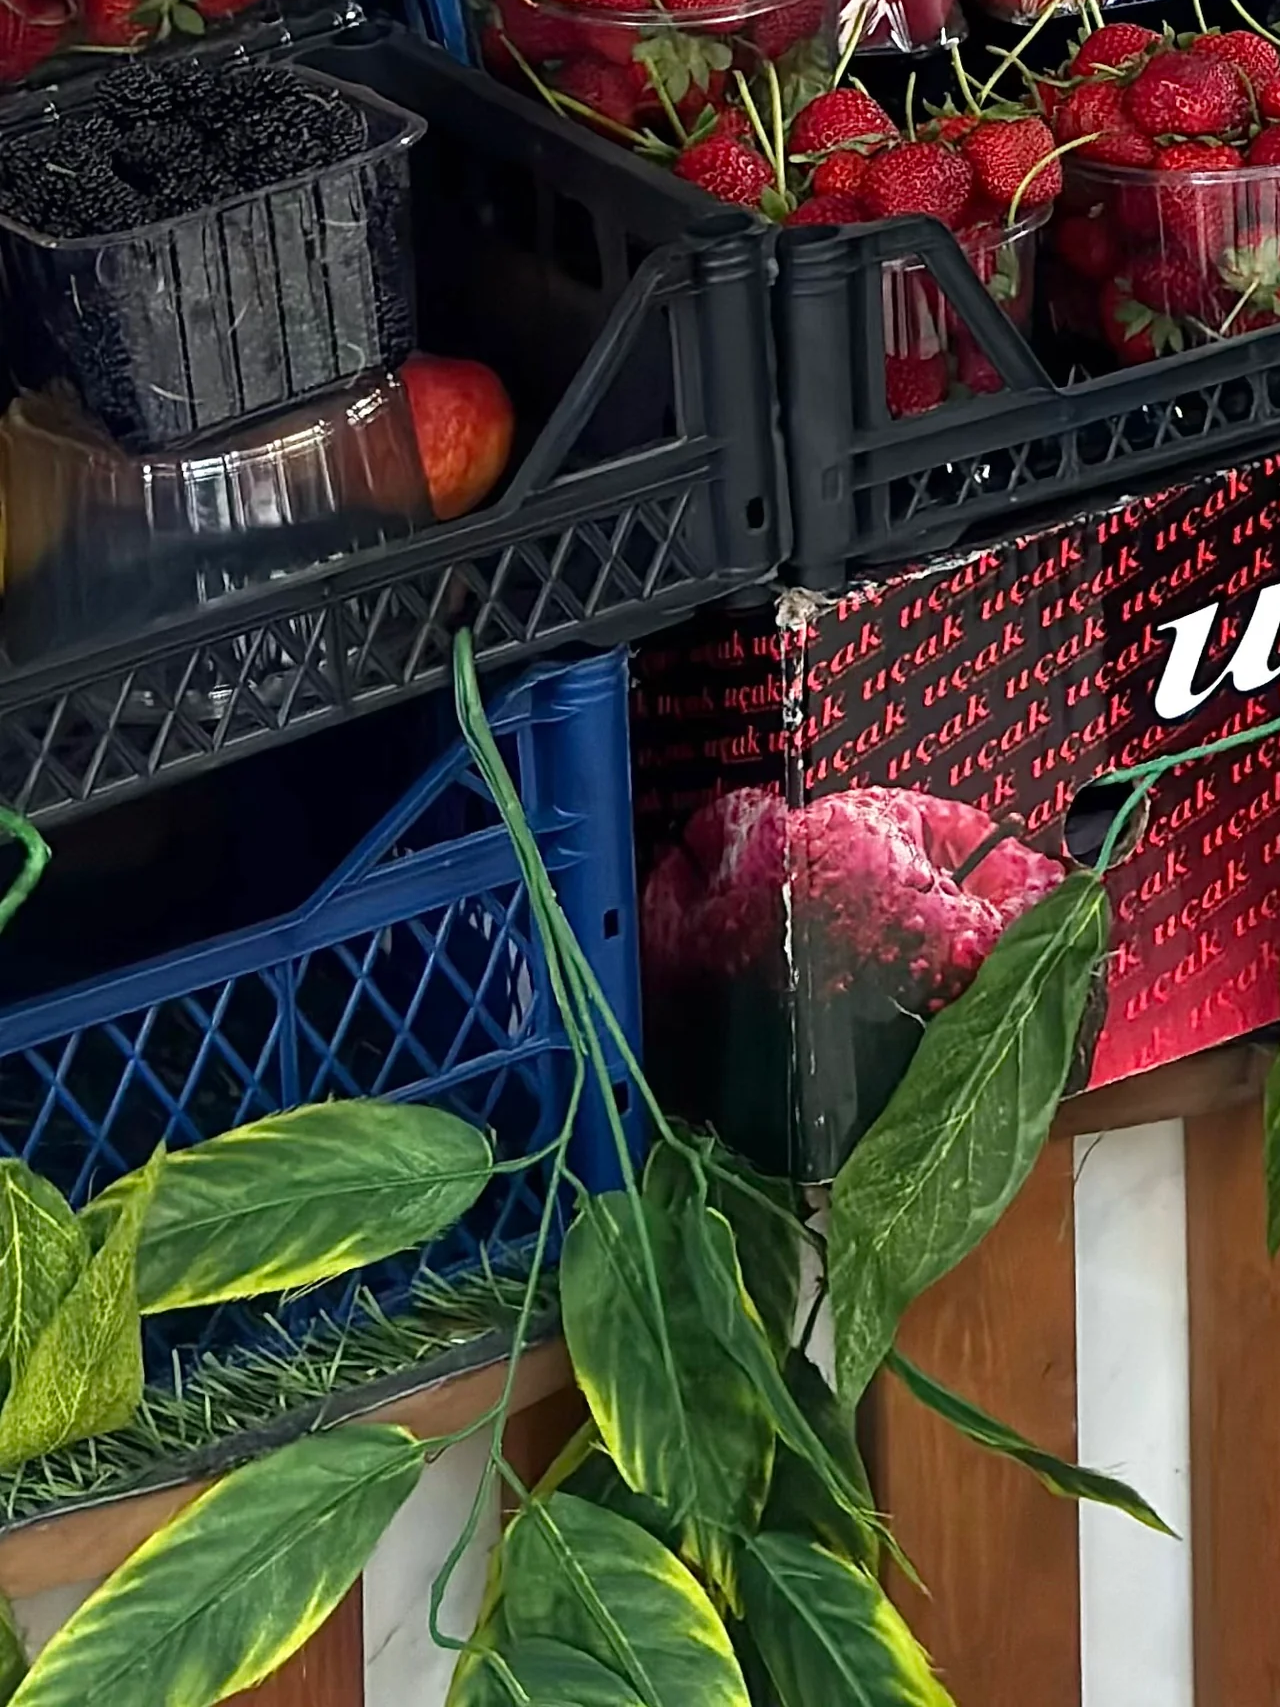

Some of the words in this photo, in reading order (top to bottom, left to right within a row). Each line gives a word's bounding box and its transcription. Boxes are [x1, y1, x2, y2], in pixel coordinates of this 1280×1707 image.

[806, 699, 911, 789] uçak
[925, 619, 1027, 706] uçak
[1040, 541, 1140, 626] uçak
[1152, 465, 1249, 548] uçak
[861, 610, 965, 698] uçak
[978, 532, 1079, 617] uçak
[890, 691, 994, 780] uçak
[1007, 612, 1108, 698] uçak
[1120, 535, 1218, 619] uçak
[954, 699, 1056, 788] uçak
[1036, 692, 1136, 779] uçak
[1154, 858, 1251, 947] uçak
[1122, 930, 1220, 1020] uçak
